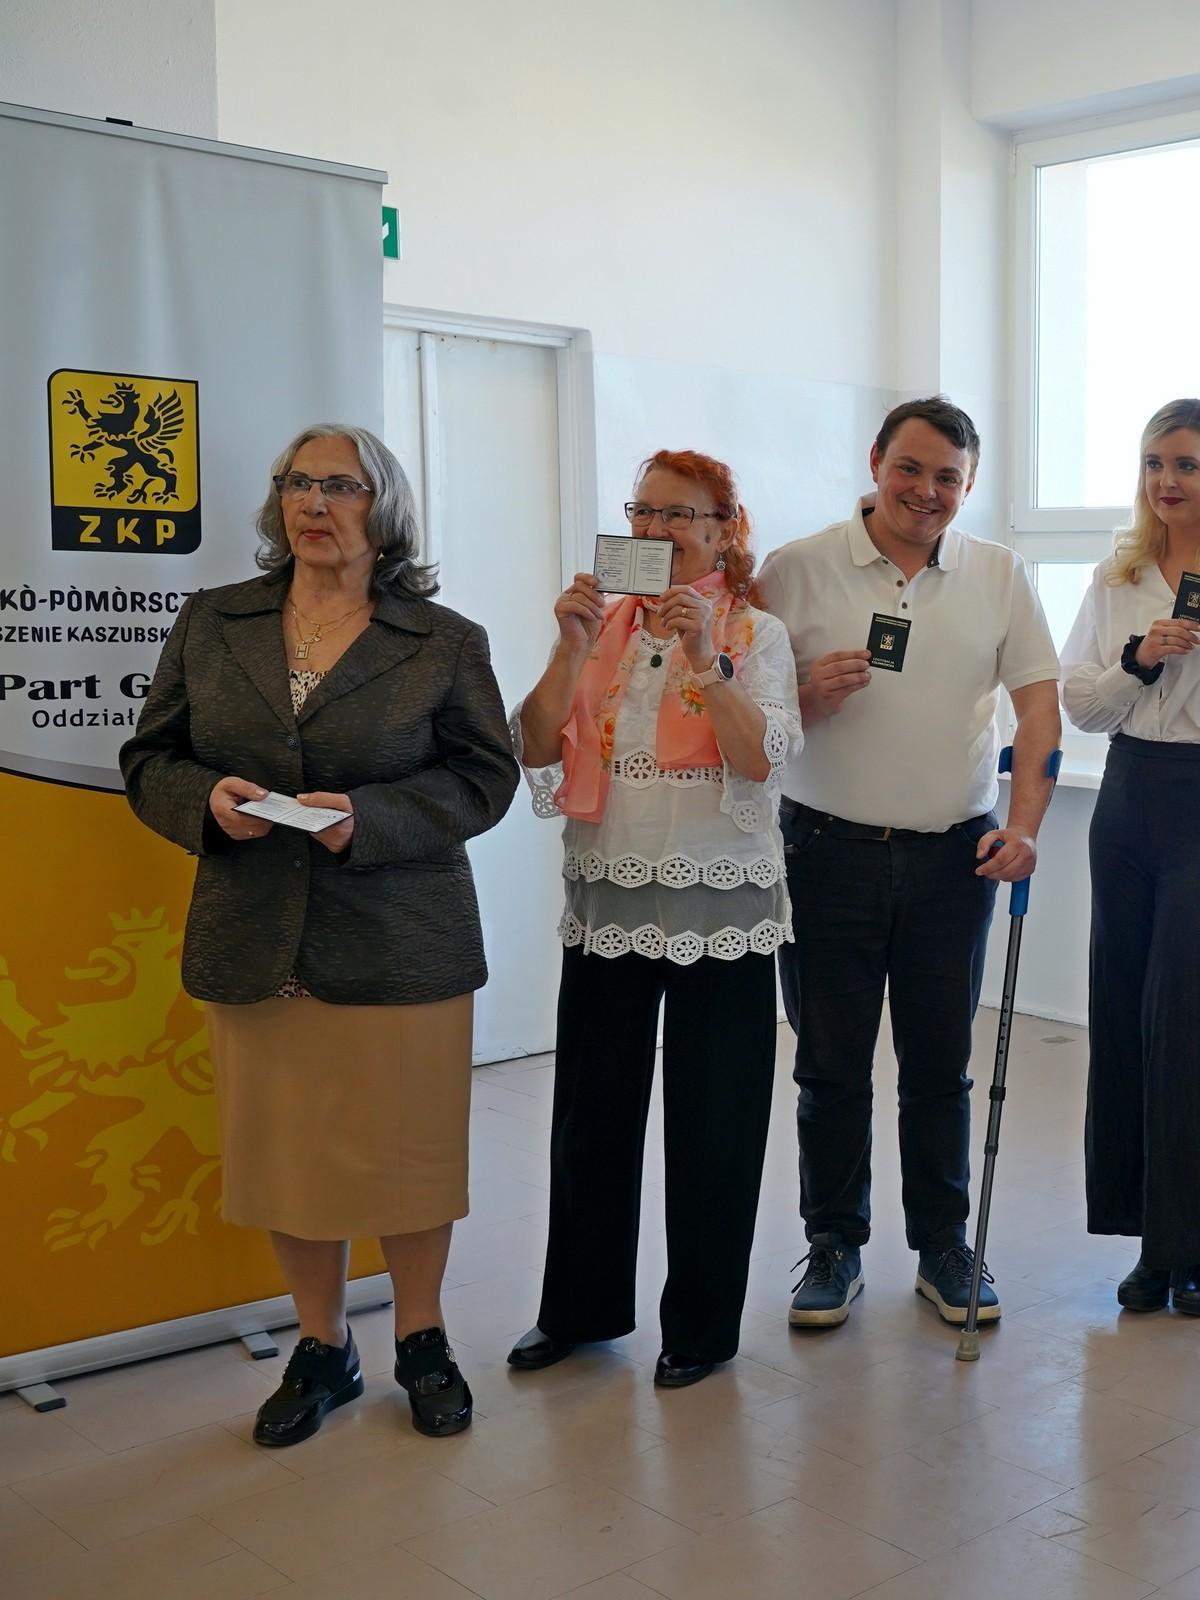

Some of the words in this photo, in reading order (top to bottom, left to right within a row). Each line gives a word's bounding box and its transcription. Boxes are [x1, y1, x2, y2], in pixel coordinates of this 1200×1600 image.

[79, 515, 176, 546] ZKP
[0, 584, 204, 613] KÒ-PÒMÒRSC
[0, 674, 101, 700] Part
[31, 707, 135, 728] Oddział
